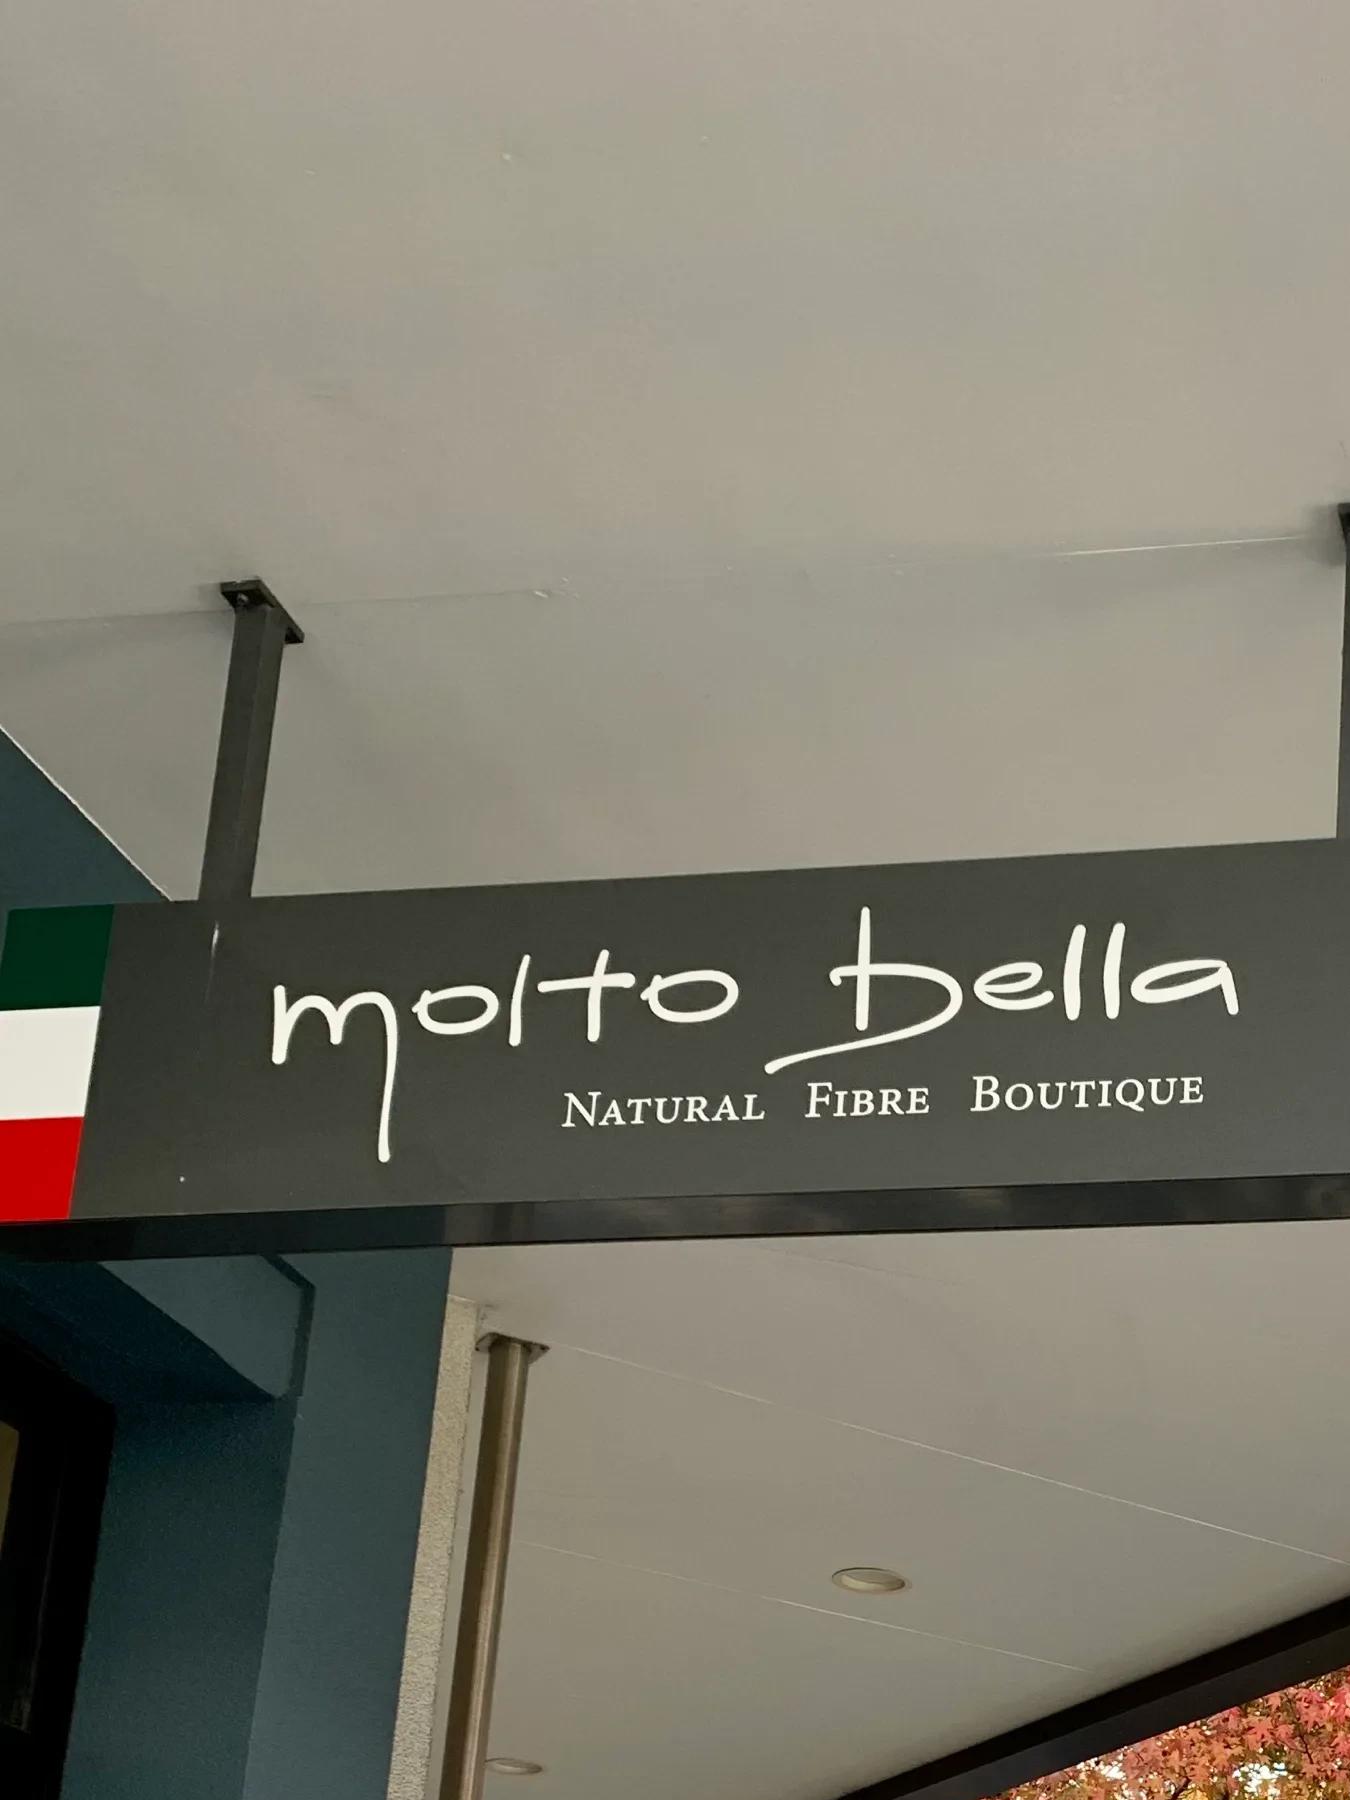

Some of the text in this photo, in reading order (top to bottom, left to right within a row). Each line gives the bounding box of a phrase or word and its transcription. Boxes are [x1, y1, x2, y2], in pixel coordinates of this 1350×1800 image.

[271, 906, 1240, 1164] molto bella
[560, 1074, 1206, 1128] NATURAL FIBRE BOUTIQUE
